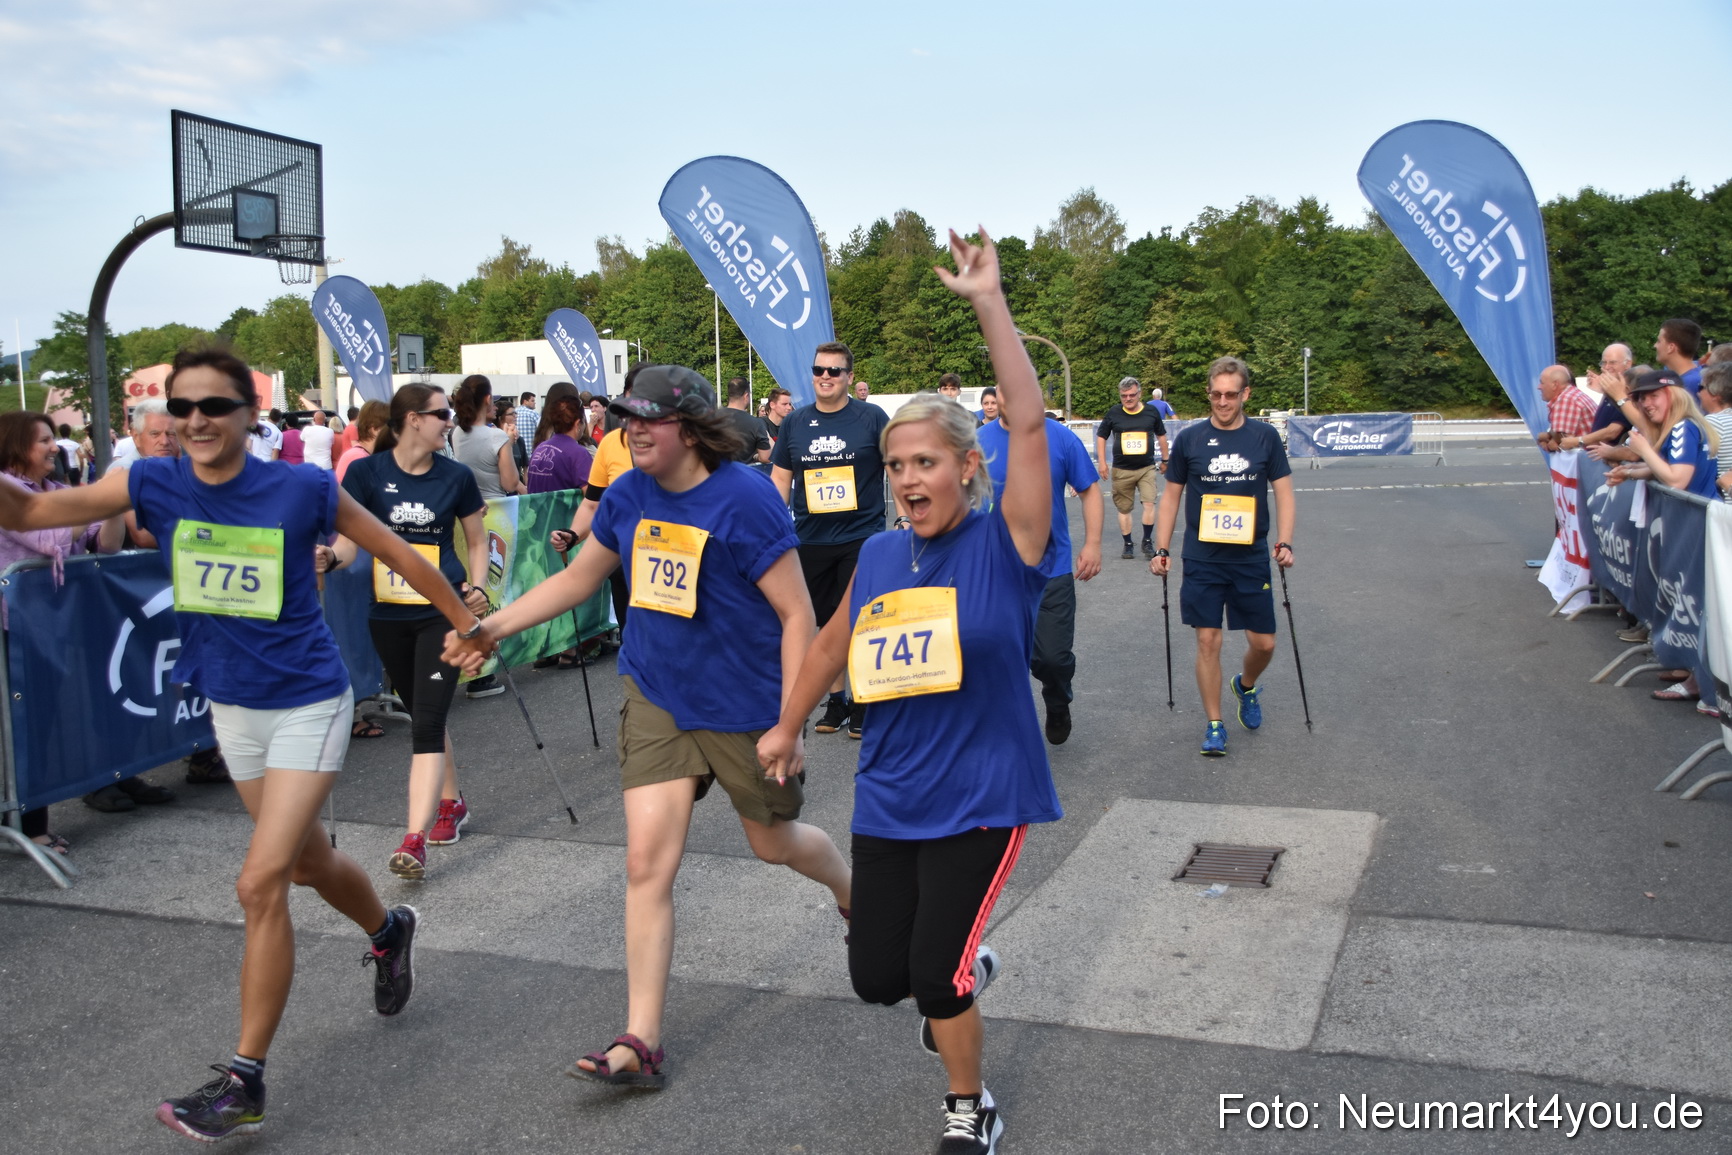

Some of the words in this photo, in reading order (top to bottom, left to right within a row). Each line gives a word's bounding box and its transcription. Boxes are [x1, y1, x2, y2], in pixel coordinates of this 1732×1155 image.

[129, 382, 160, 396] G6
[1126, 440, 1142, 449] 835
[1326, 432, 1387, 444] Fischer
[1332, 443, 1383, 451] AUTOMOBILE
[846, 452, 855, 460] is!
[816, 485, 846, 500] 179
[390, 505, 435, 525] Burgis
[1212, 514, 1243, 530] 184
[195, 560, 261, 593] 775
[648, 556, 687, 590] 792
[202, 594, 230, 602] Manuela
[230, 596, 256, 605] Kastner
[868, 629, 933, 671] 747
[868, 678, 886, 686] Erika
[886, 670, 946, 683] Kordon-Hoffmann
